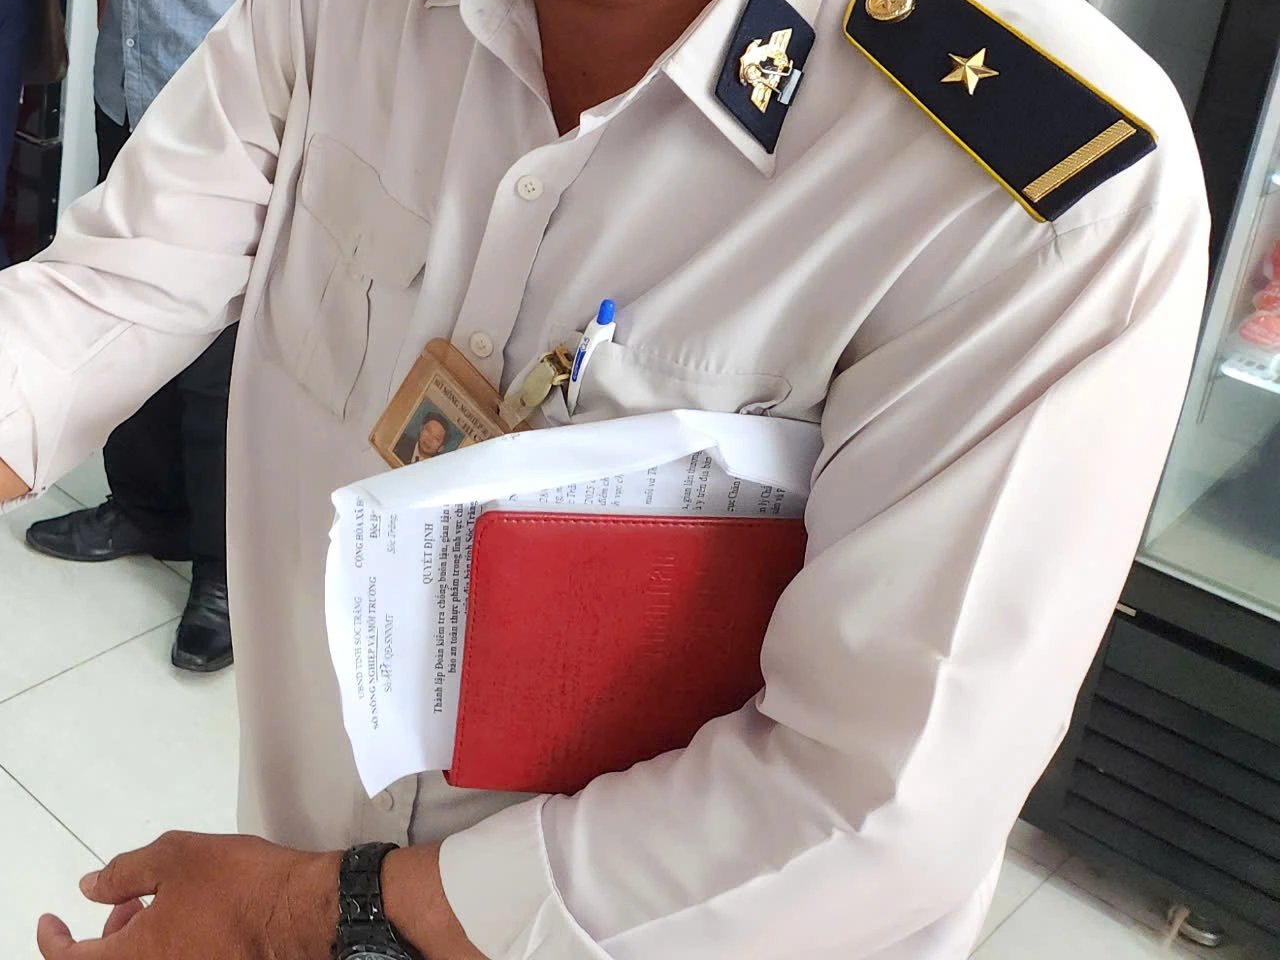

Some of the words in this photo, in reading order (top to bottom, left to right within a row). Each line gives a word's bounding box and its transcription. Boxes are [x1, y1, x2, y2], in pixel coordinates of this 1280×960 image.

[424, 523, 435, 549] ĐỊNH
[440, 524, 450, 543] gian
[452, 536, 461, 552] lĩnh
[438, 561, 447, 582] buôn
[452, 553, 461, 576] trong
[435, 583, 447, 609] chống
[448, 577, 460, 602] phẩm
[450, 604, 460, 624] thực
[434, 626, 445, 647] kiểm
[449, 627, 458, 644] toàn
[435, 648, 444, 669] Đoàn
[434, 672, 445, 685] lập
[433, 686, 443, 714] Thành
